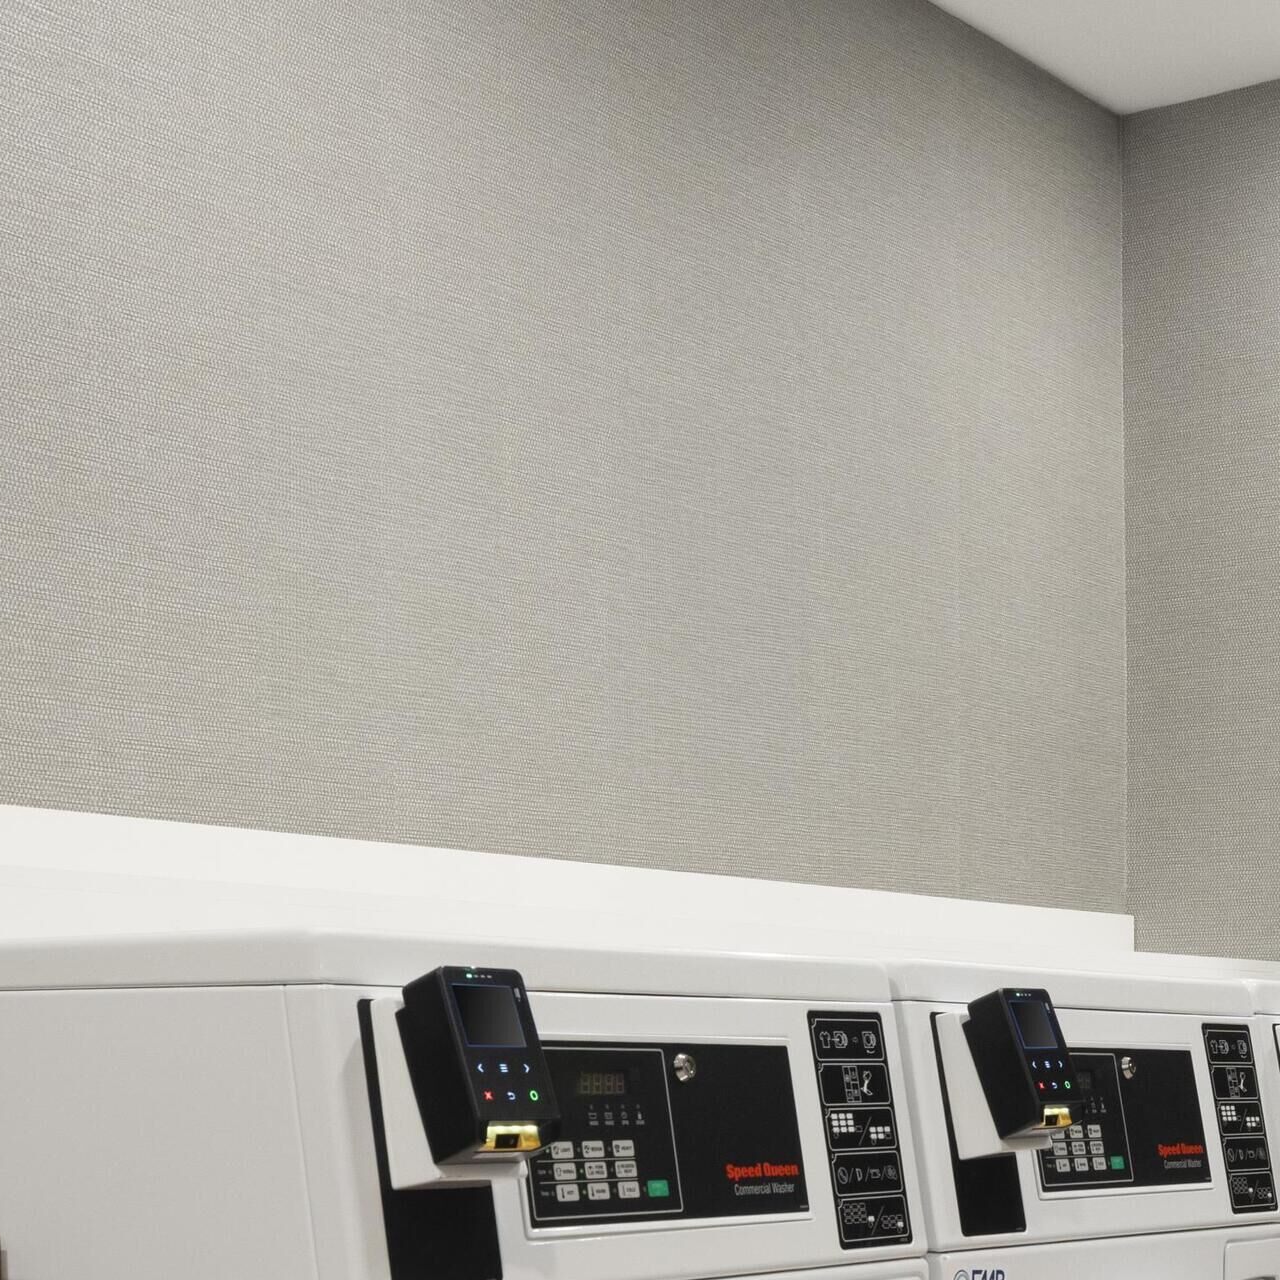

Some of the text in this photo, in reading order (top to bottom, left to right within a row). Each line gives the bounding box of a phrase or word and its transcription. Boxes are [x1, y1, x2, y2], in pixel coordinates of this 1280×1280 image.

[1158, 1143, 1204, 1158] Speed Queen
[726, 1162, 799, 1181] Speed Queen
[734, 1182, 795, 1196] Commercial Washer
